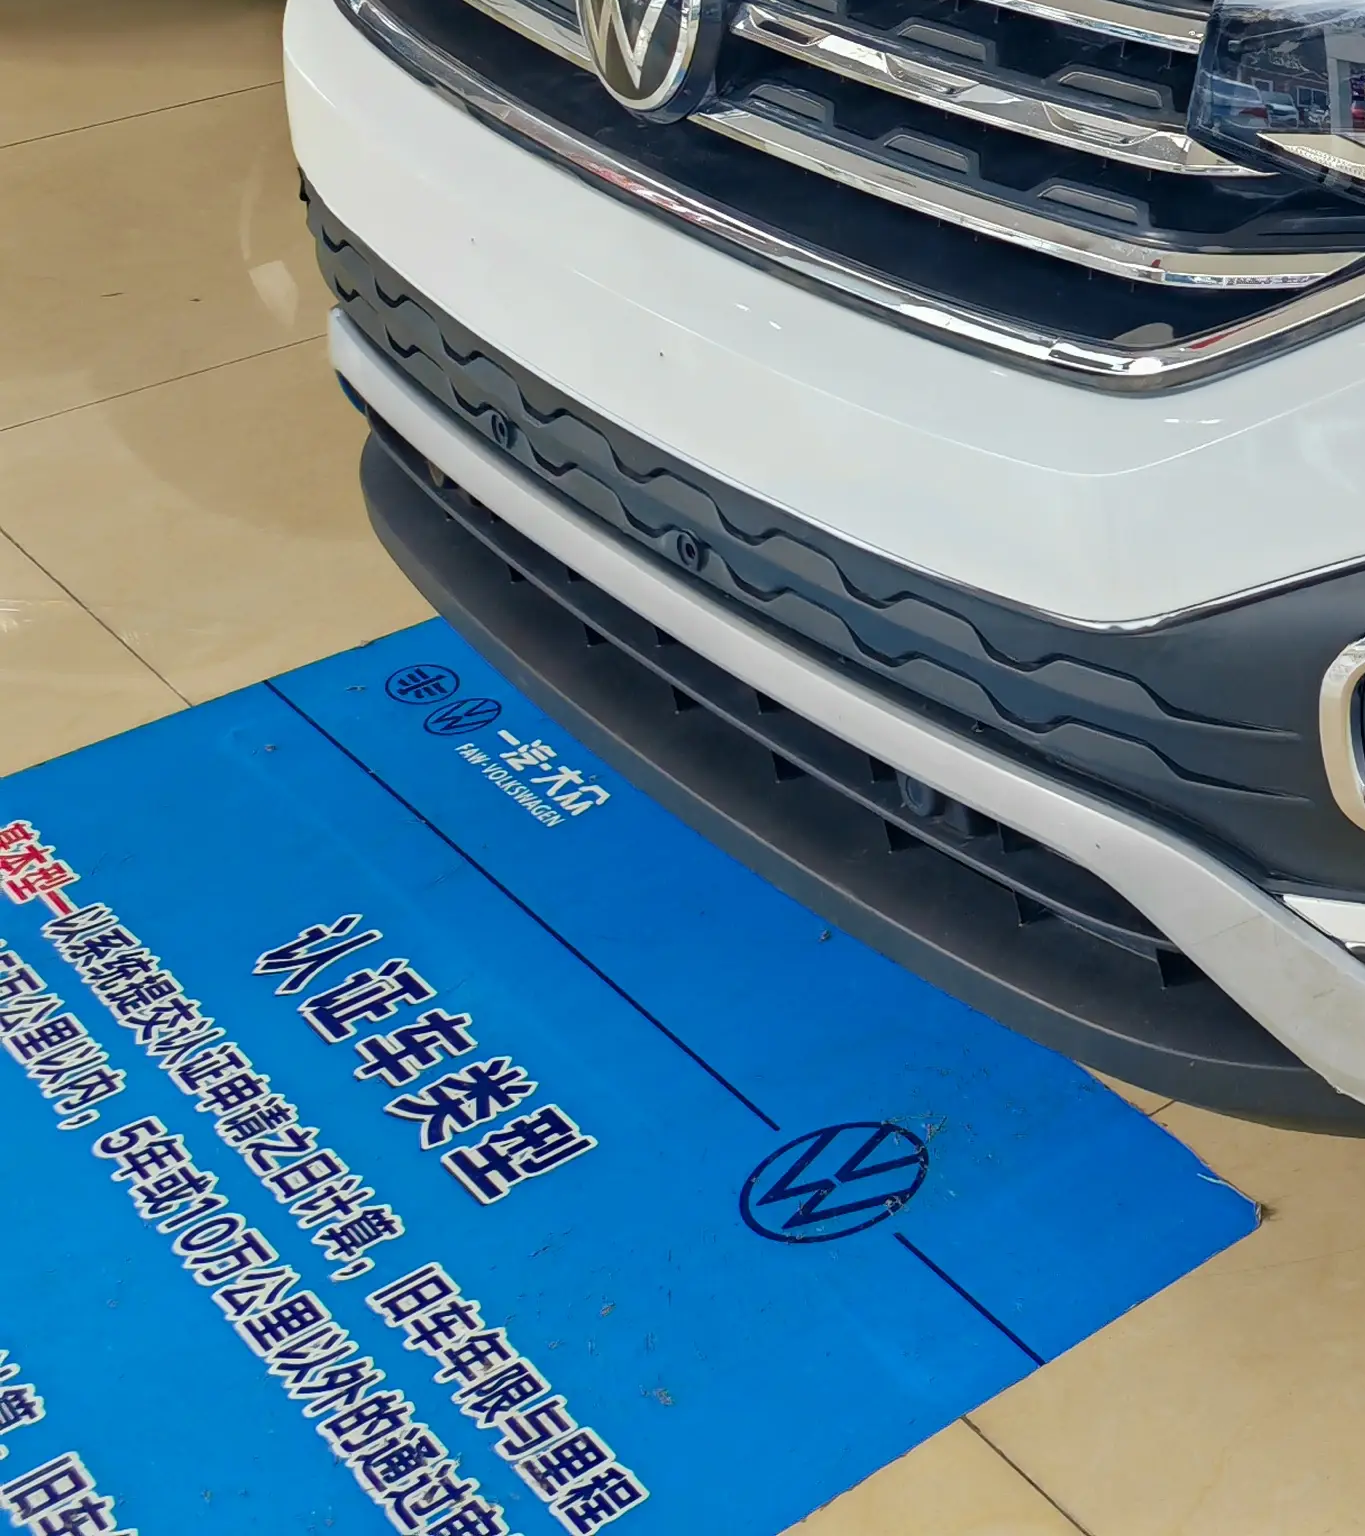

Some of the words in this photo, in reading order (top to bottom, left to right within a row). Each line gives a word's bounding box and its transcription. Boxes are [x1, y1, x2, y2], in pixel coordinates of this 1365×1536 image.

[454, 742, 566, 828] FAW-VOLKSWAGEN
[497, 729, 611, 816] 一汽-大众
[253, 914, 597, 1205] 认证车类型
